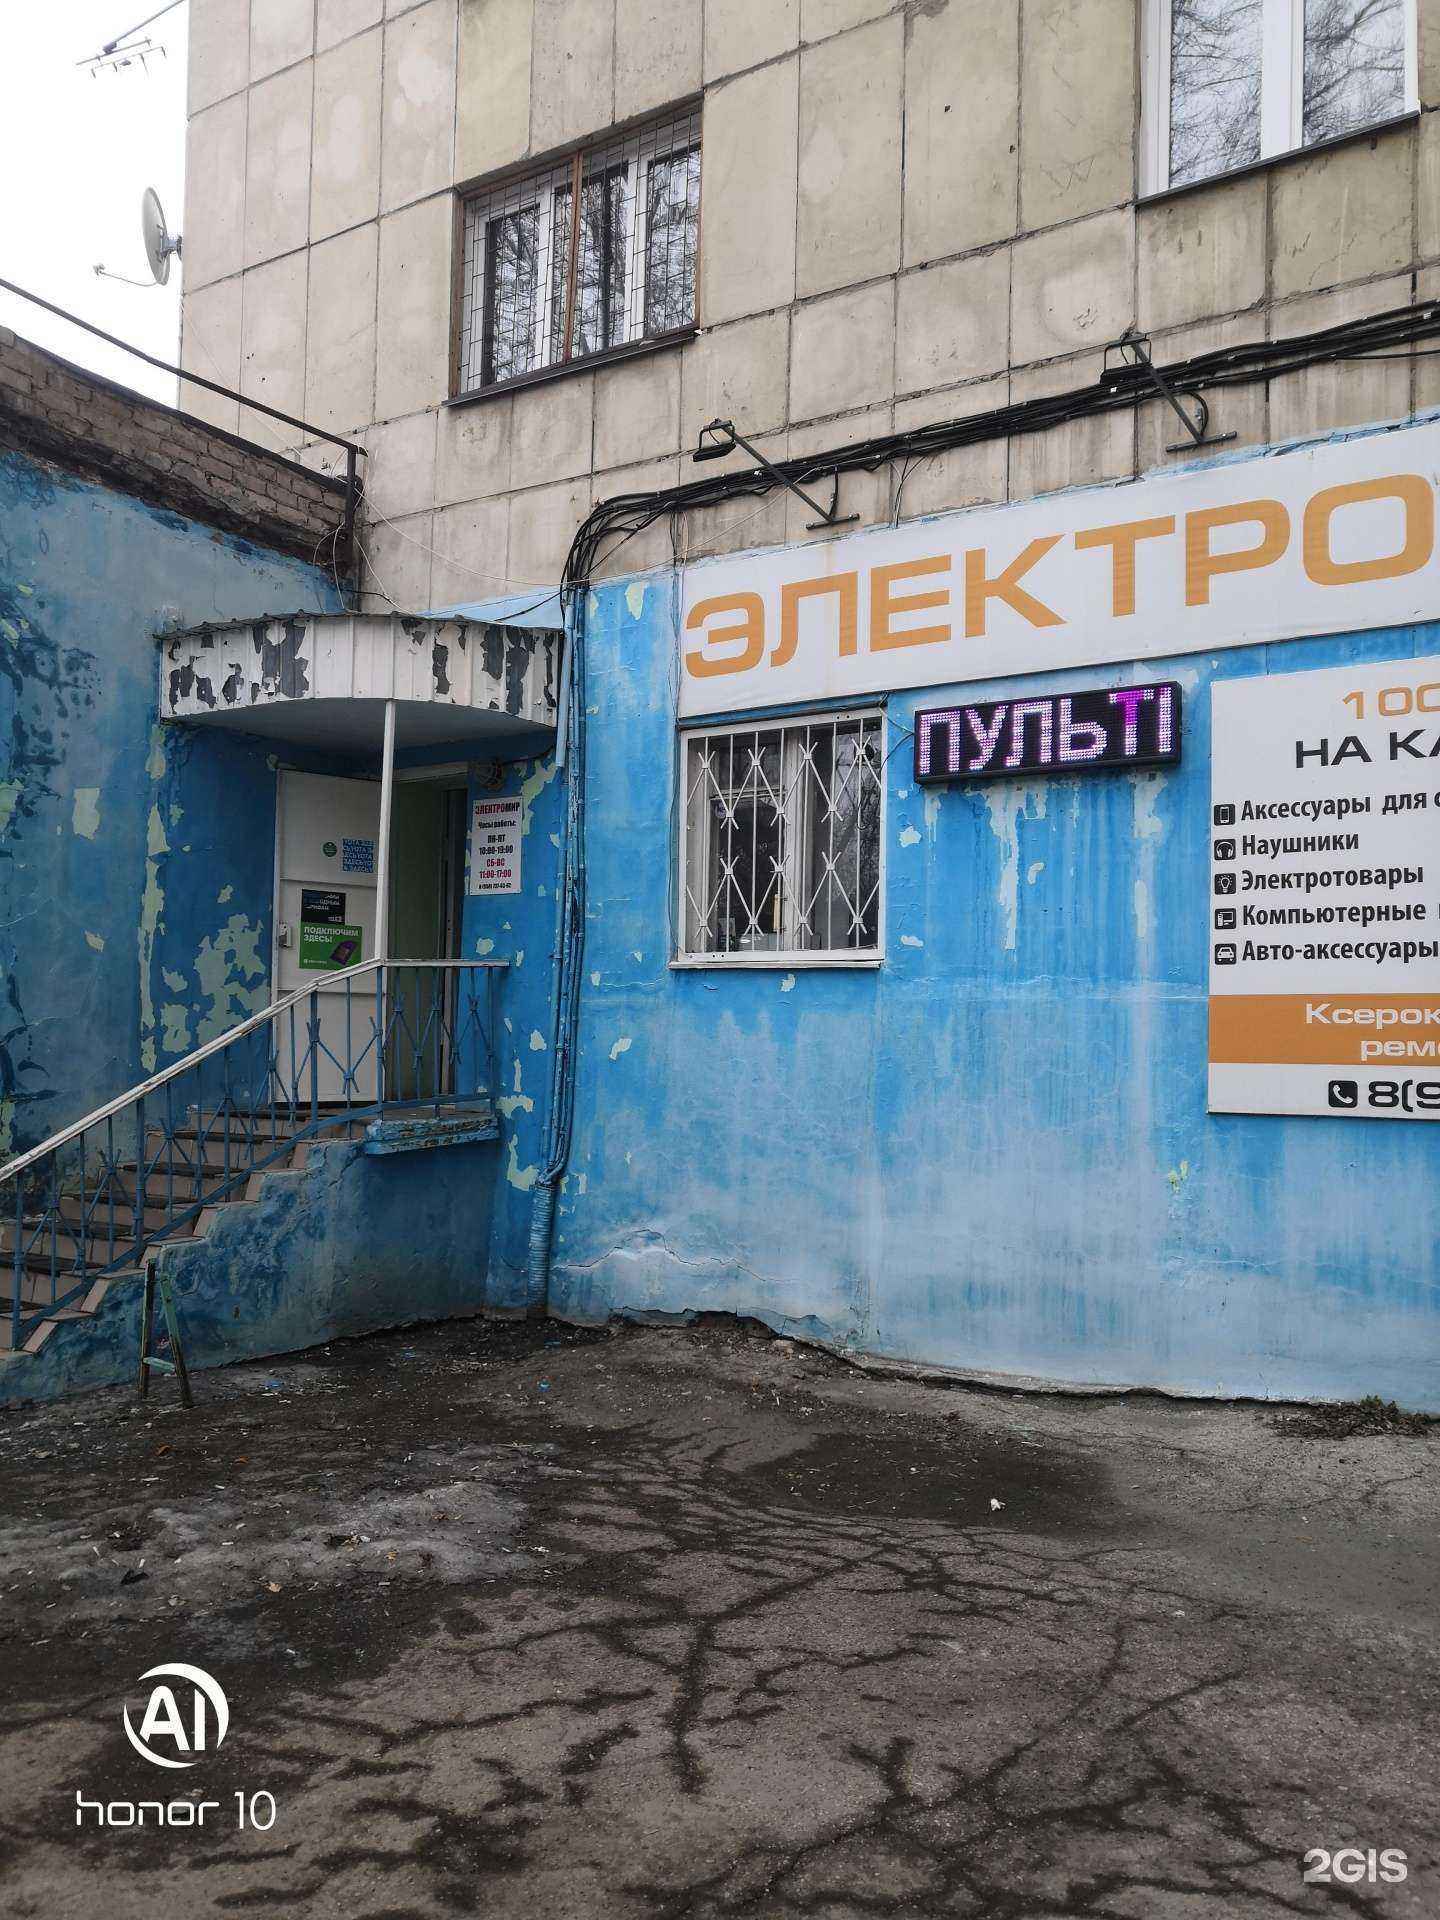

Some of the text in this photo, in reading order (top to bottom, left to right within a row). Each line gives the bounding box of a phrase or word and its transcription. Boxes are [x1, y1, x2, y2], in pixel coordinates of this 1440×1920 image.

[685, 474, 1434, 678] ЭЛЕКТРО
[1296, 736, 1373, 768] НА
[475, 802, 520, 814] ЭЛЕКТРОМИР
[1241, 796, 1371, 823] Аксессуары
[1382, 792, 1427, 815] для
[1242, 830, 1359, 857] Наушники
[1241, 865, 1424, 893] Электротовары
[1242, 902, 1427, 930] Компьютерные
[304, 926, 359, 937] ПОДКЛЮЧИМ
[1242, 940, 1439, 966] Авто-аксессуары
[1360, 1039, 1440, 1062] рем
